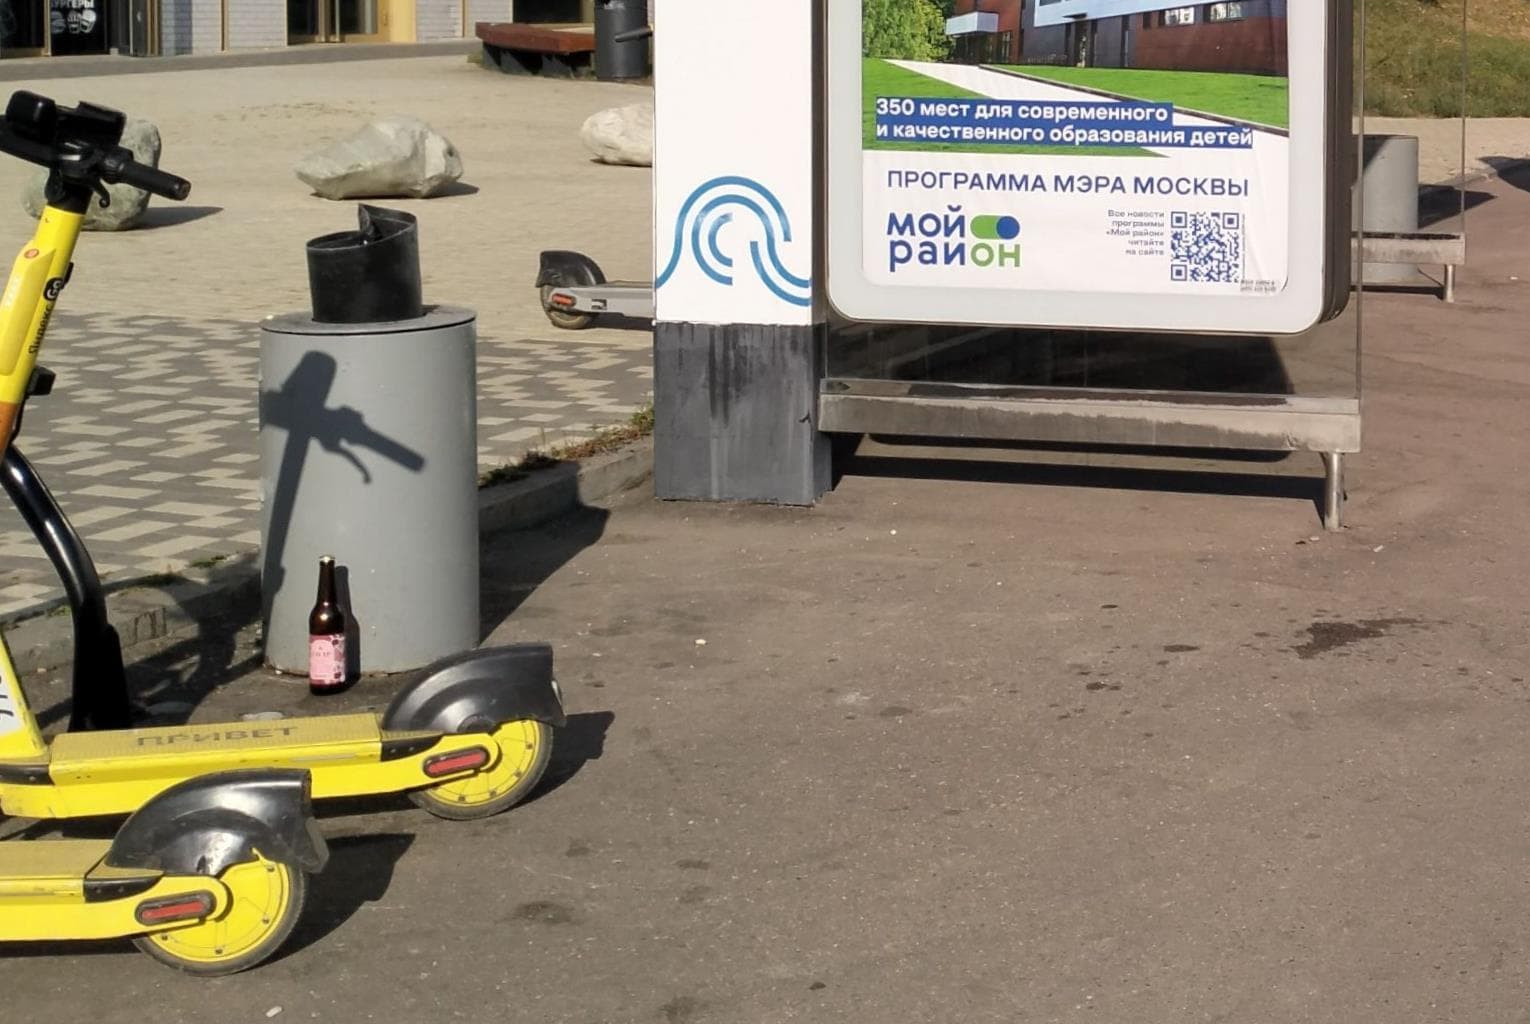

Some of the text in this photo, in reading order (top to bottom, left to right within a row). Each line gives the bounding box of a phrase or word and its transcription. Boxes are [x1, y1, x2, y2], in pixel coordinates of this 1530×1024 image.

[876, 98, 1168, 123] 350 мест для современного
[876, 124, 1253, 145] и качественного образования детей
[888, 170, 1248, 196] ПРОГРАММА МЭРА МОСКВЫ
[887, 204, 965, 238] мой
[1108, 209, 1125, 217] Все
[1128, 238, 1164, 246] читайте
[138, 726, 298, 746] ПРИВЕТ
